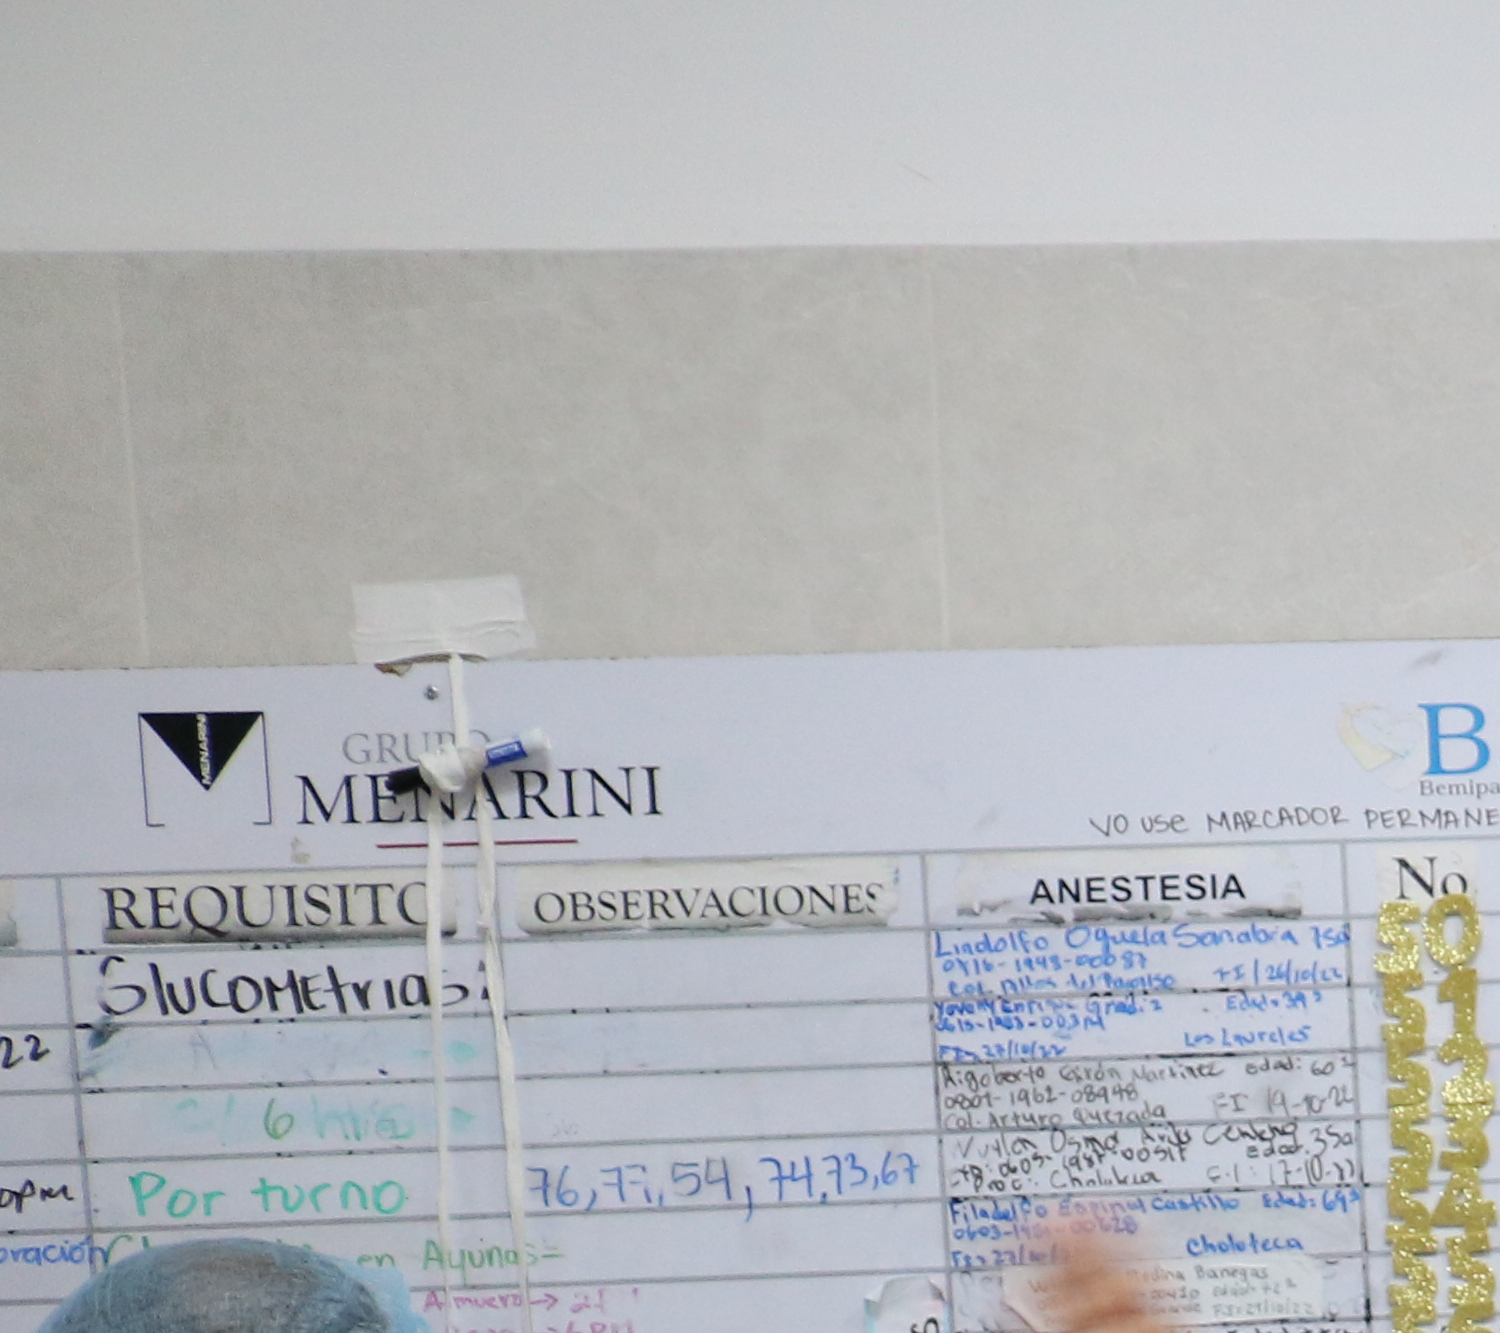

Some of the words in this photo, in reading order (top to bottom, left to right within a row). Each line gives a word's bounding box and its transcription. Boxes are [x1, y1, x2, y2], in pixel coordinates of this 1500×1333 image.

[1206, 806, 1350, 834] MARCADOR
[1030, 873, 1247, 905] ANESTESIA
[1394, 856, 1470, 899] No
[534, 884, 885, 927] OBSERVACIONES
[1373, 892, 1482, 975] 50
[127, 1172, 226, 1220] Por
[252, 1175, 409, 1217] turno
